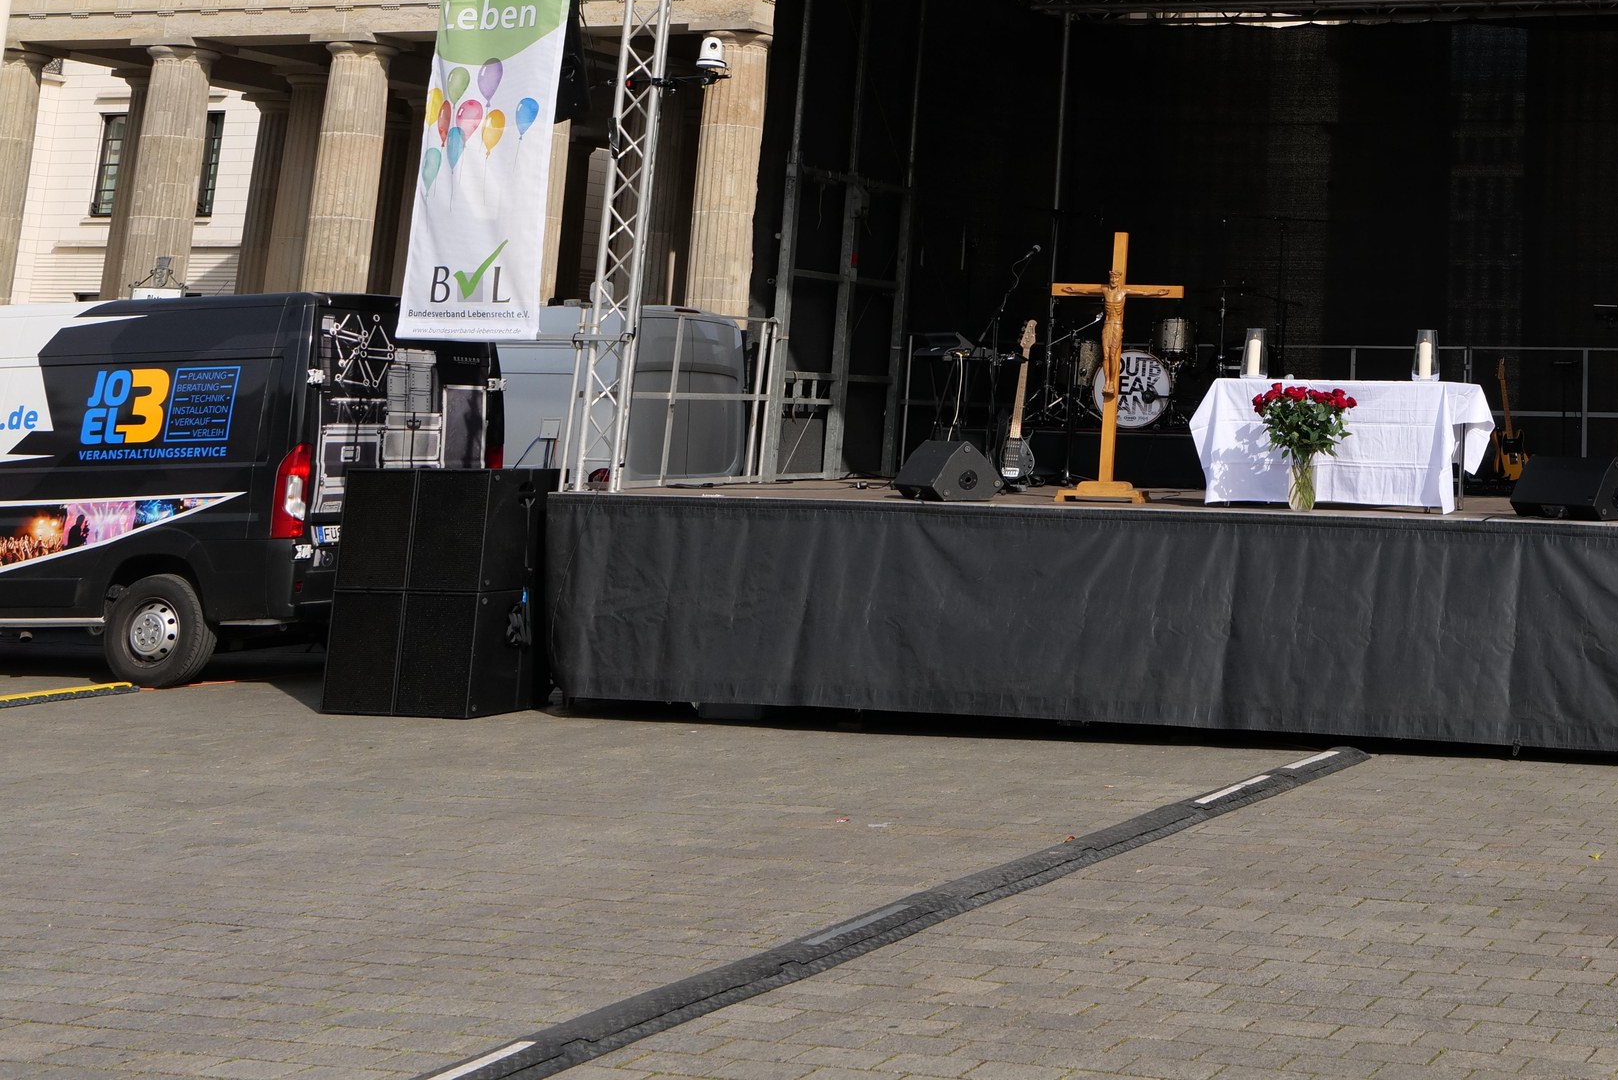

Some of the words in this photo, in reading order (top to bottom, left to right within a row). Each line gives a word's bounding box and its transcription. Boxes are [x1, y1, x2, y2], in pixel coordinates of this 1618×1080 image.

[444, 0, 537, 30] Leben
[408, 310, 465, 318] Bundesverband
[467, 310, 515, 319] Lebensrecht
[187, 371, 228, 380] PLANUNG
[176, 383, 220, 392] BERATUNG
[190, 394, 226, 403] TECHNIK
[172, 405, 228, 415] INSTALLATION
[174, 417, 211, 426] VERKAUF
[192, 429, 224, 437] VERLEIH
[79, 446, 227, 461] VERANSTALTUNGSSERVICE
